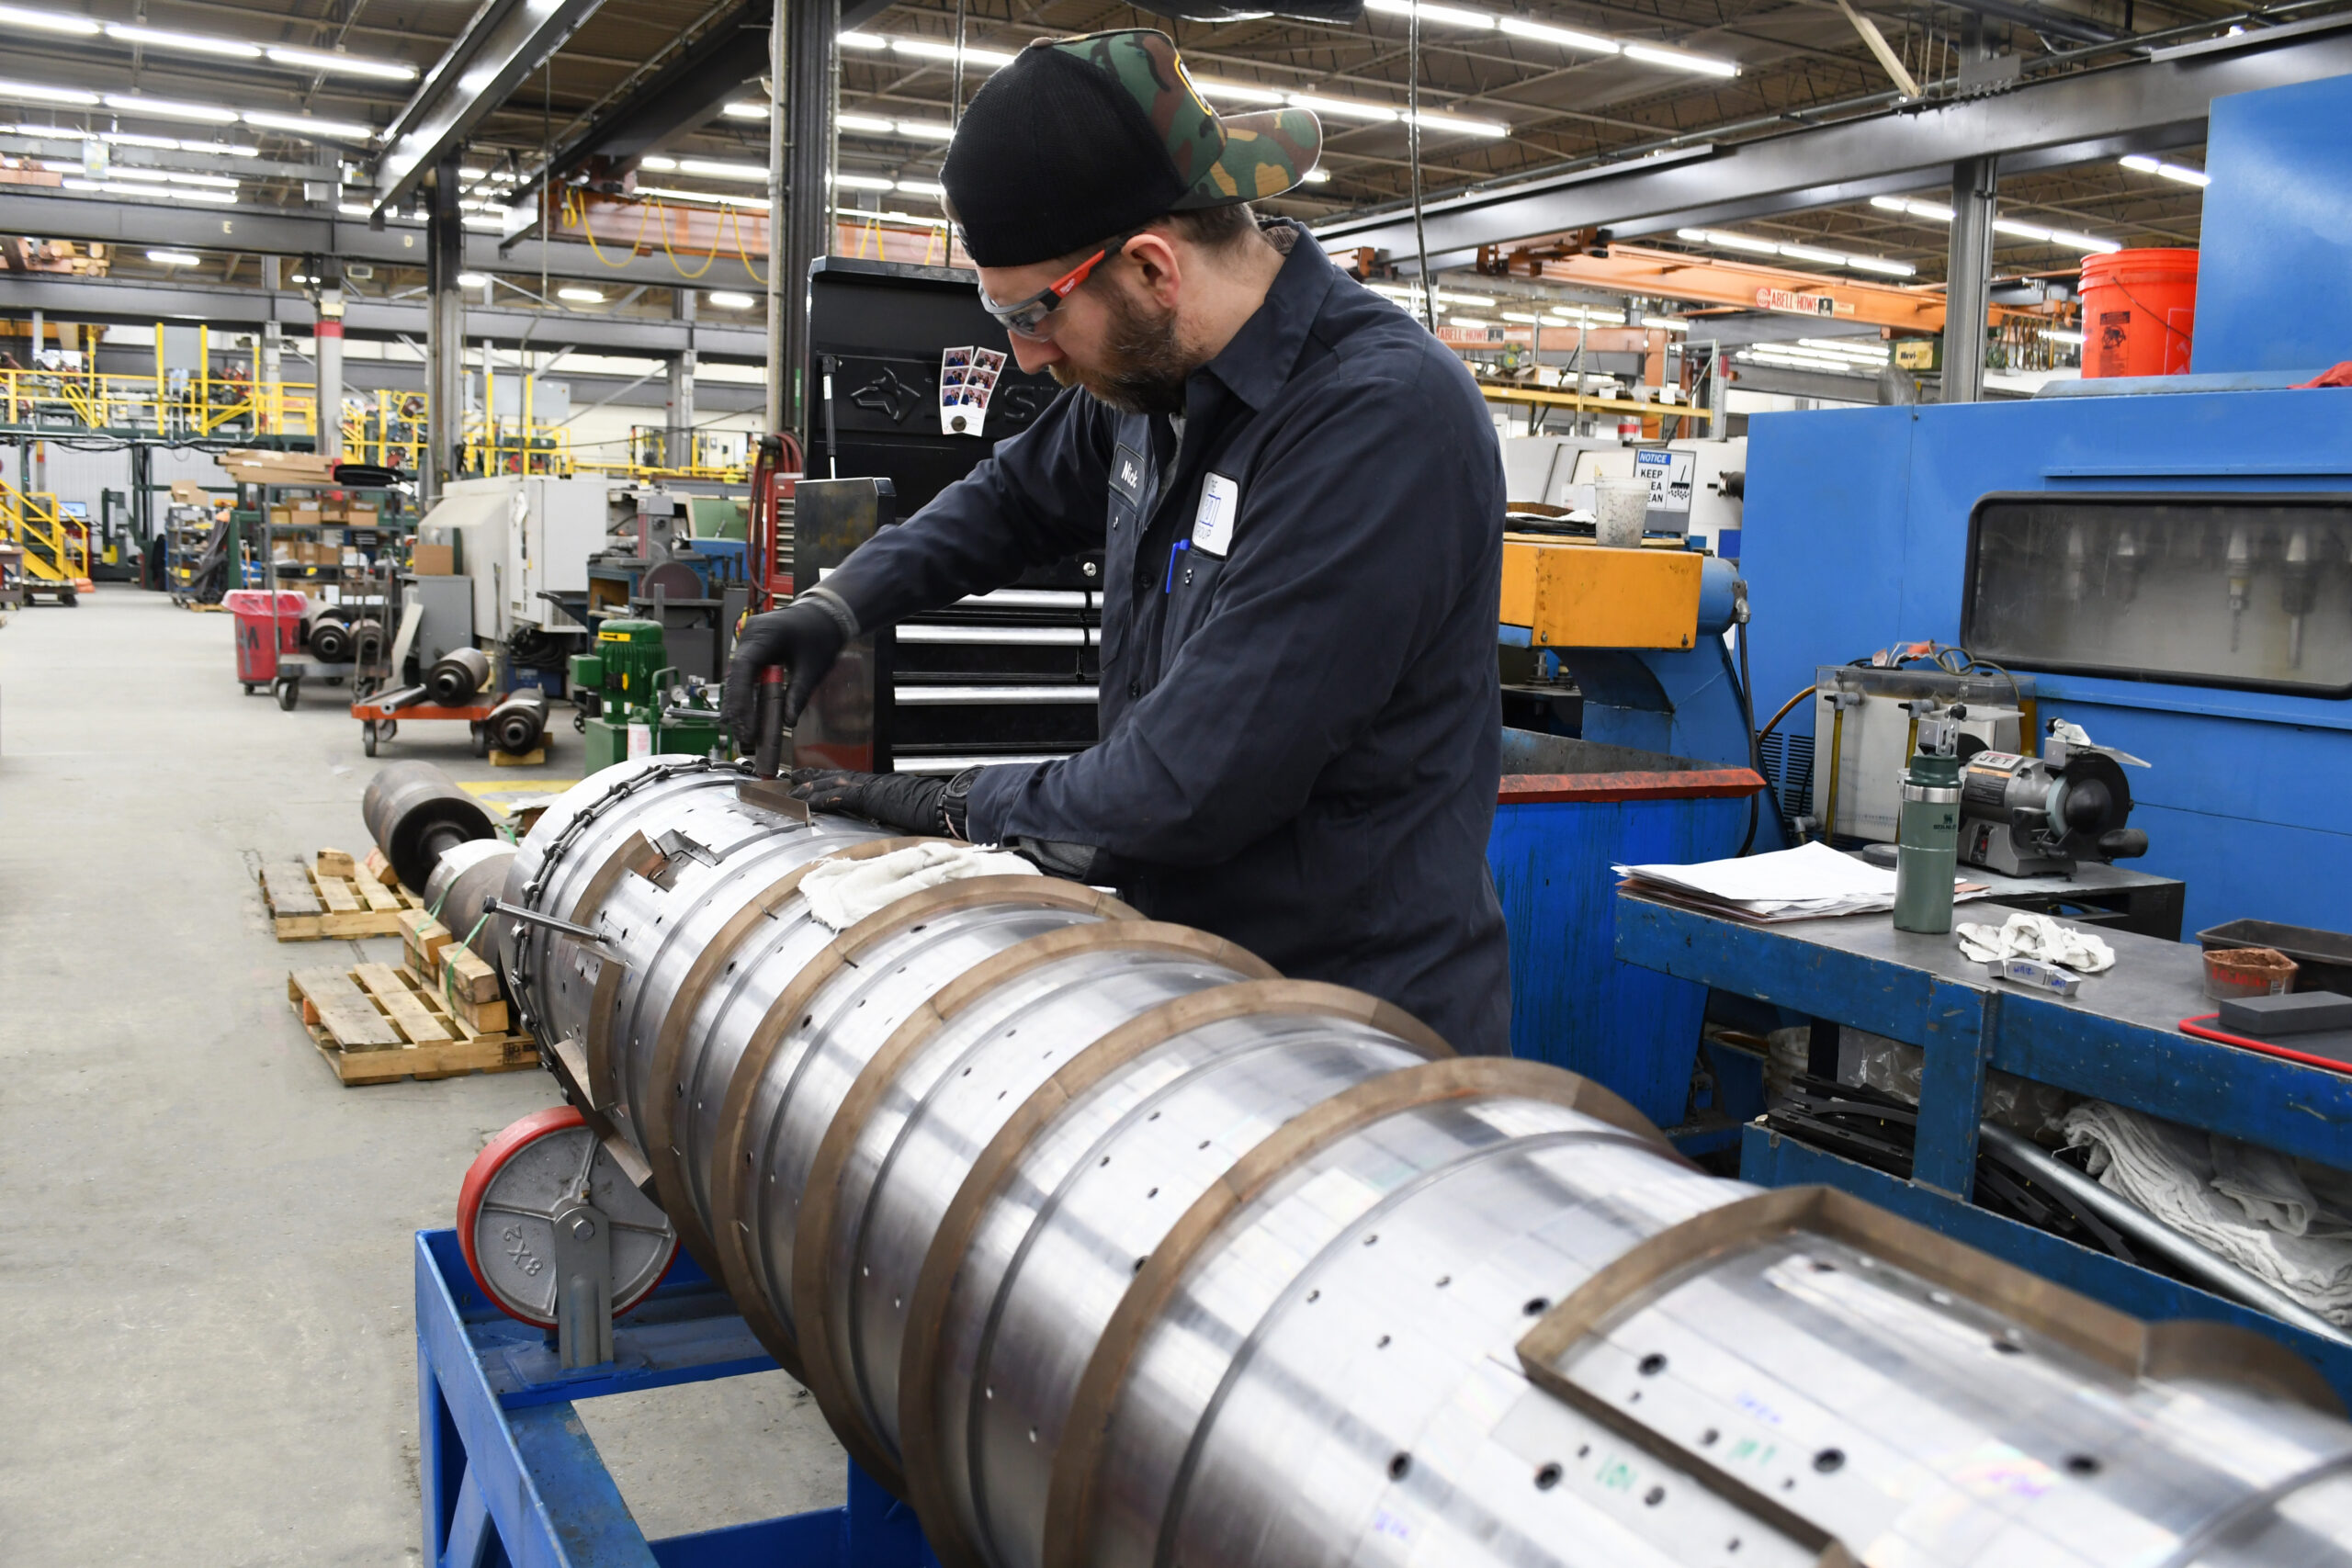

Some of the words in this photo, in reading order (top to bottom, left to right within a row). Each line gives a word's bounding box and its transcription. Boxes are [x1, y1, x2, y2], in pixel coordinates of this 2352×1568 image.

[222, 220, 232, 234] E
[1771, 290, 1793, 309] ABELL
[1796, 295, 1818, 312] HOWE
[1639, 453, 1668, 464] NOTICE
[1121, 460, 1137, 489] Nick
[1641, 468, 1663, 479] KEEP
[1651, 481, 1662, 491] EA
[1647, 493, 1664, 503] EAN
[1979, 755, 2012, 765] JET
